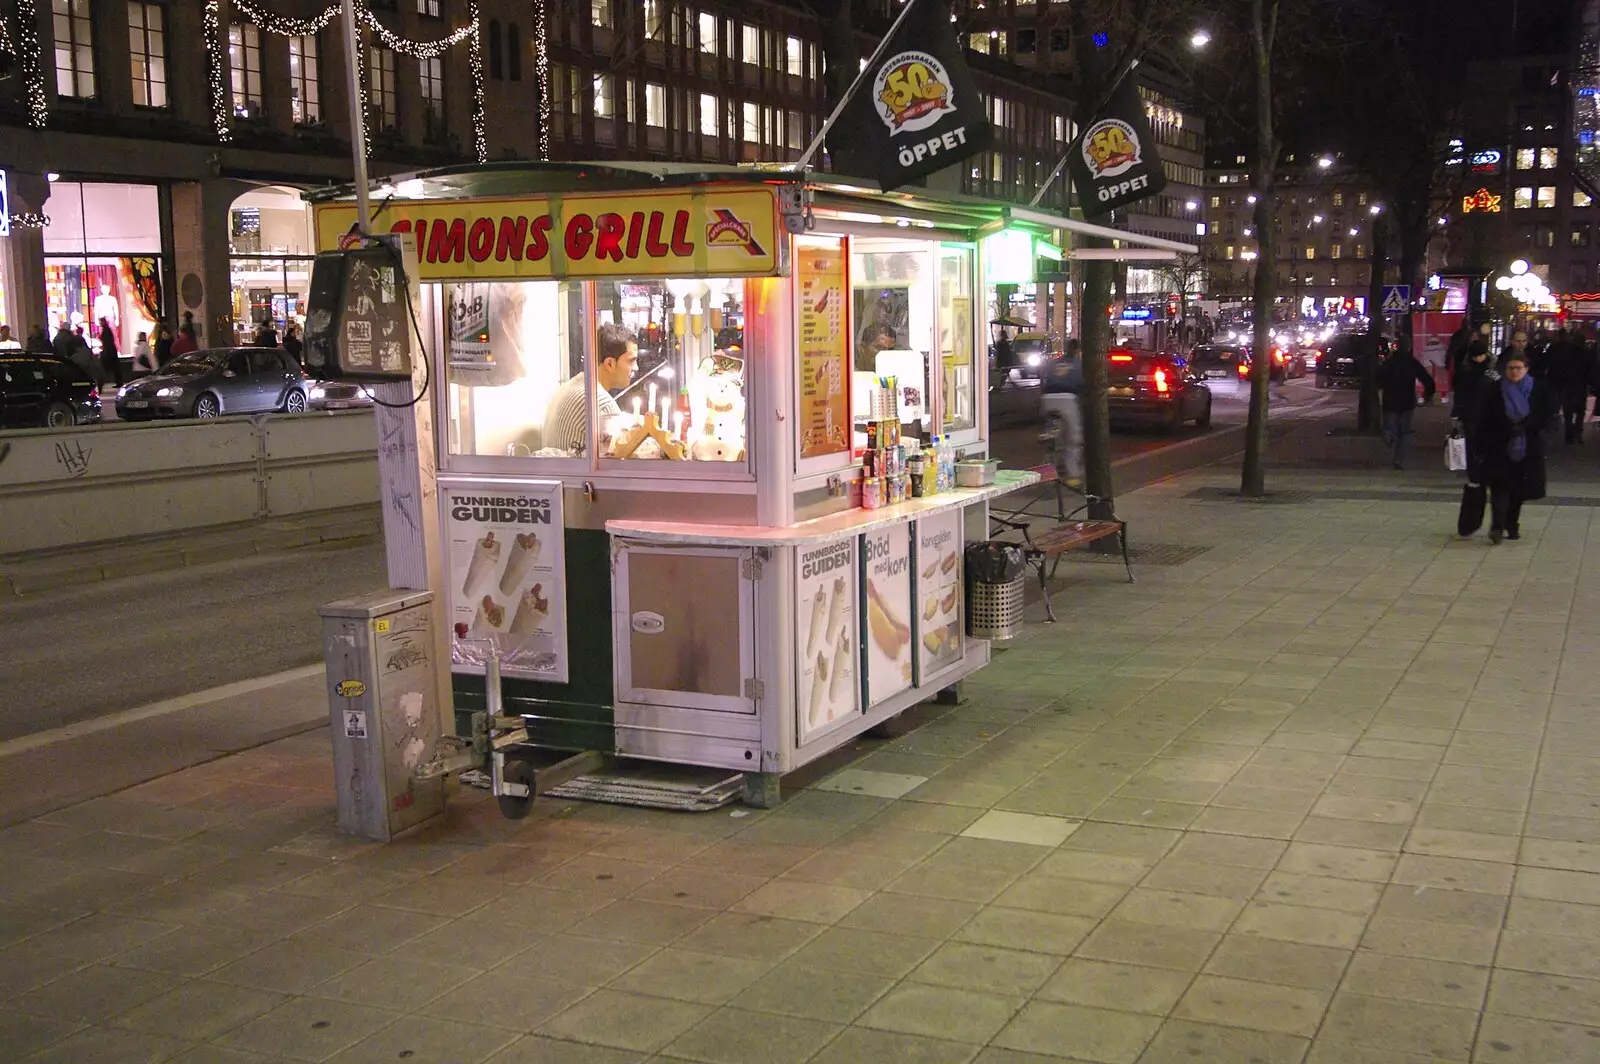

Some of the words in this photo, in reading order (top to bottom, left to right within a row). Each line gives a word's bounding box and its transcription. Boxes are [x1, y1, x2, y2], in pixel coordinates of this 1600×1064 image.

[887, 63, 929, 107] 50
[899, 126, 967, 167] ÖPPET
[1093, 127, 1124, 158] 50
[1098, 174, 1148, 202] ÖPPET
[390, 214, 553, 264] IMONS
[564, 210, 694, 262] GRILL
[451, 496, 550, 508] TUNNBRÖDS
[451, 507, 551, 524] GUIDEN
[867, 533, 890, 561] Bröd
[802, 550, 851, 580] GUIDEN
[887, 556, 908, 578] korv
[378, 622, 388, 631] EL
